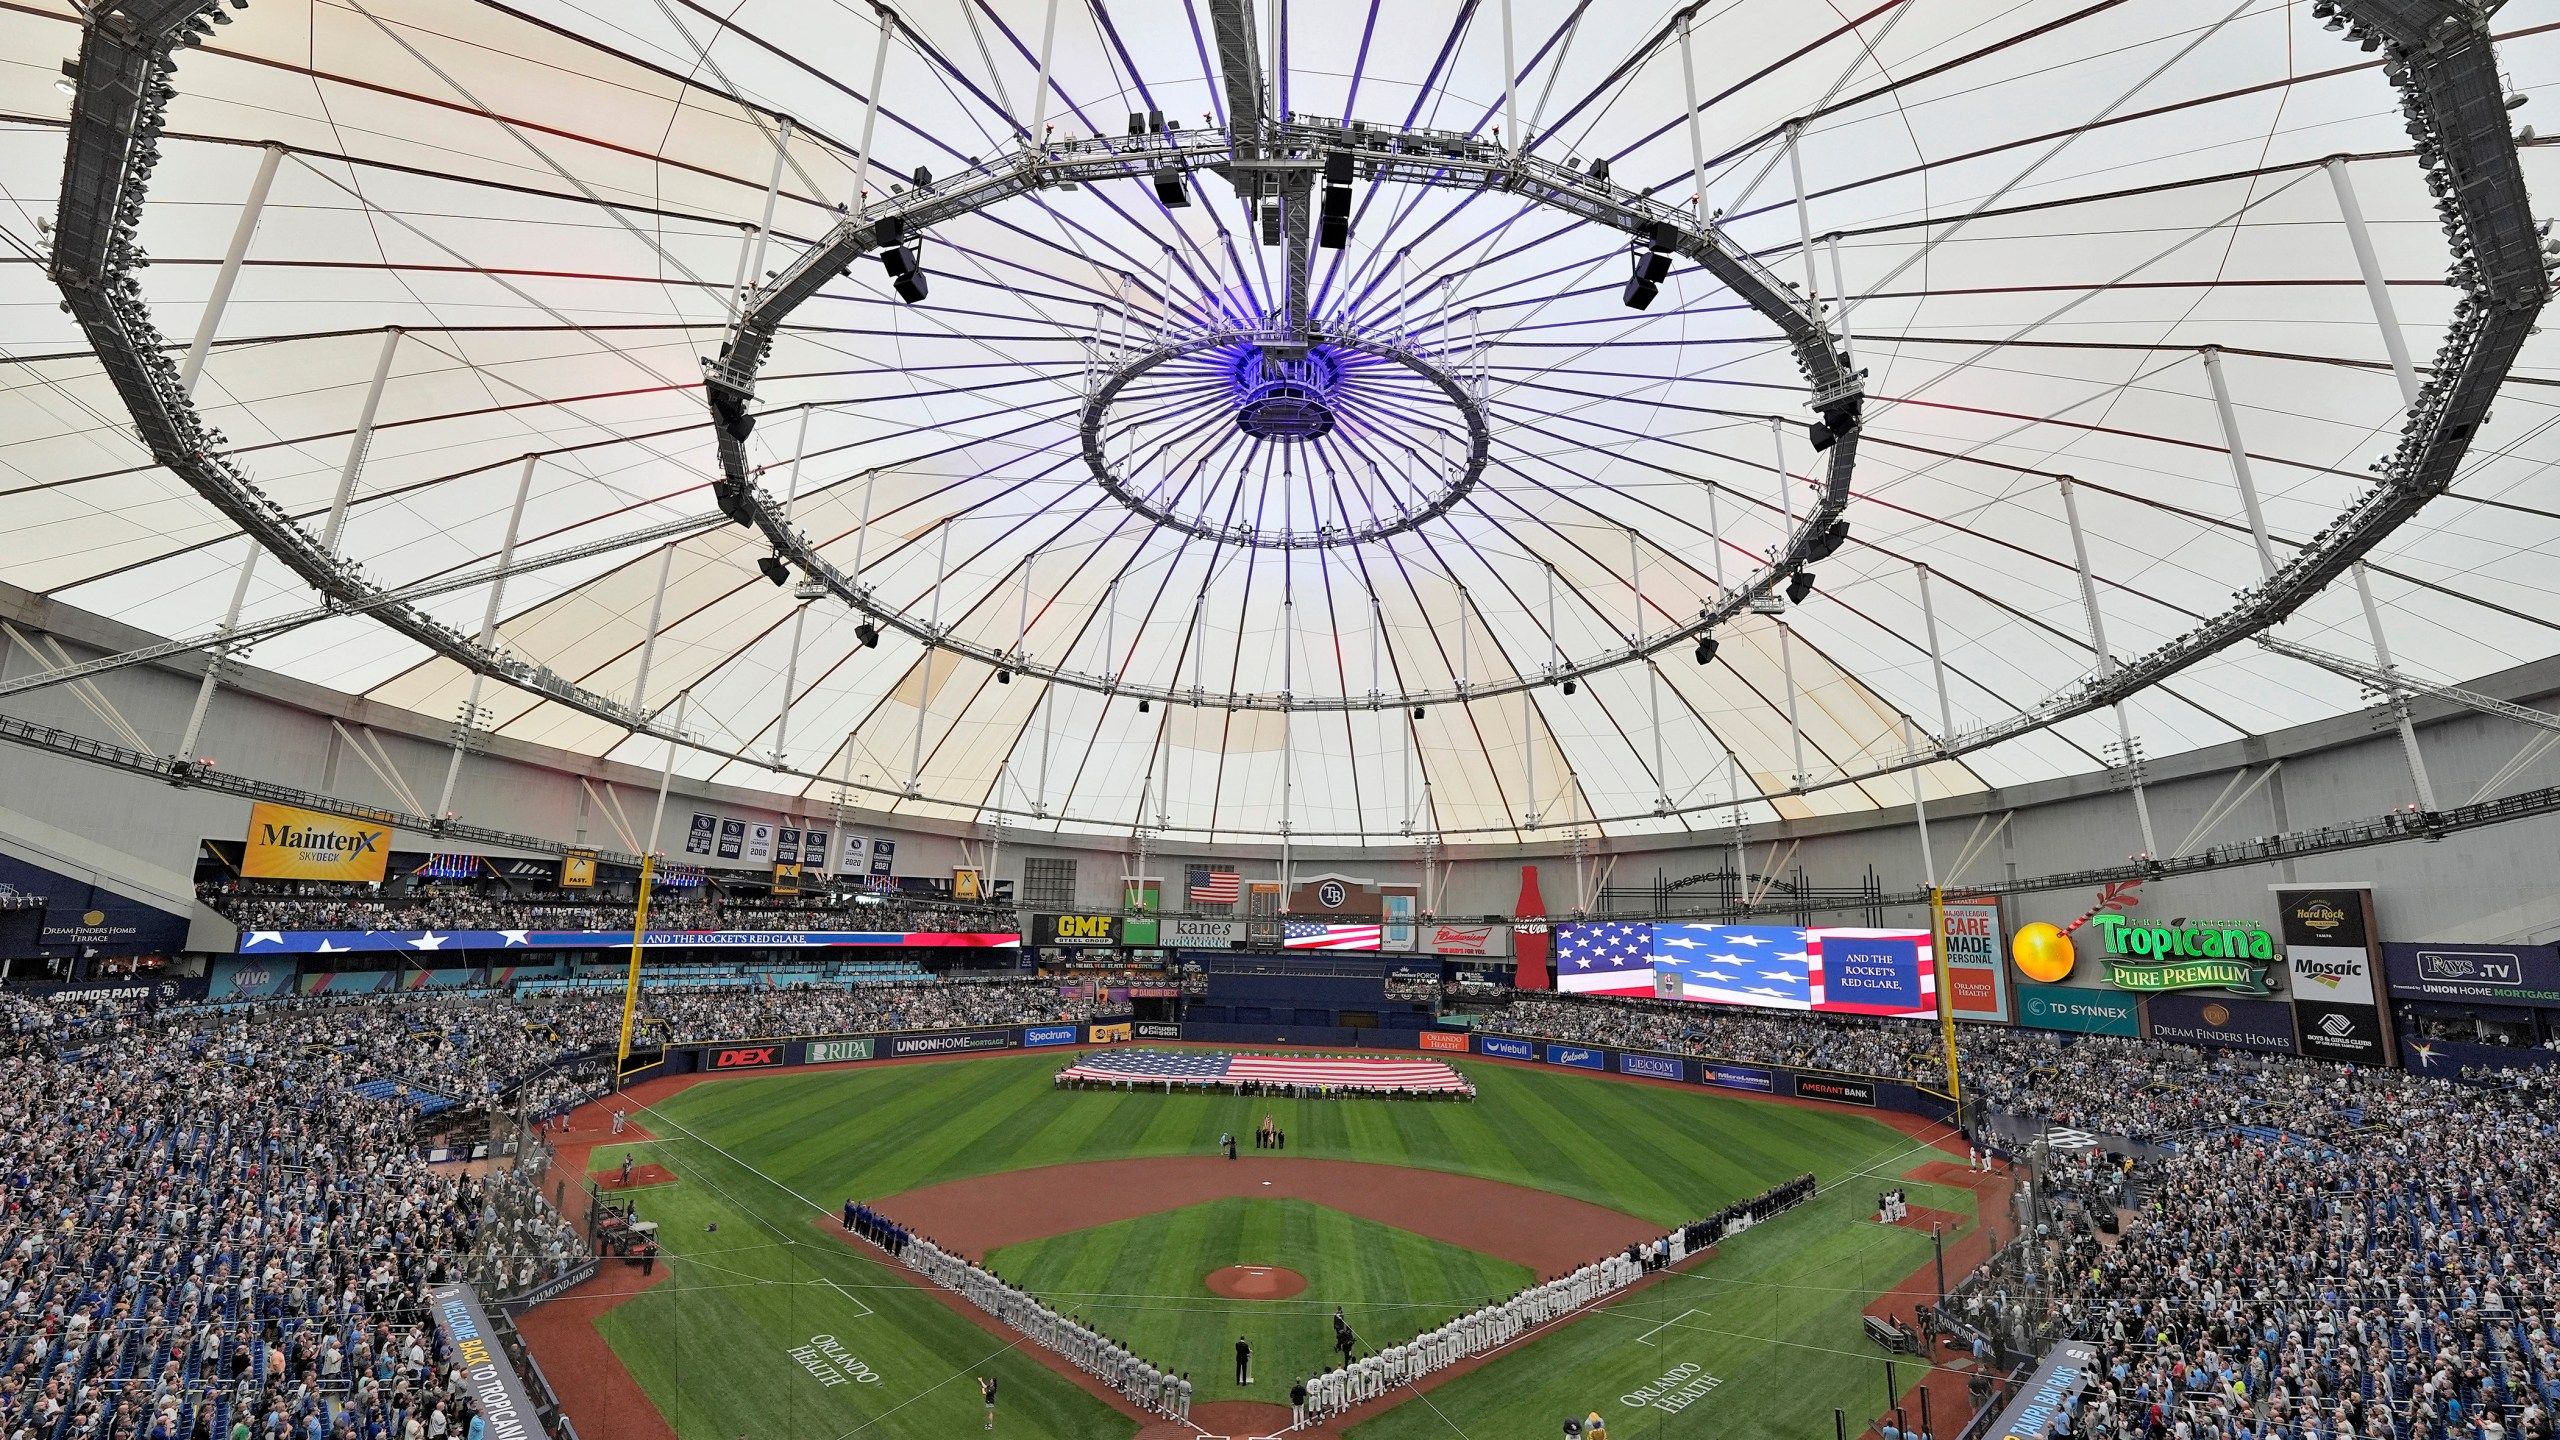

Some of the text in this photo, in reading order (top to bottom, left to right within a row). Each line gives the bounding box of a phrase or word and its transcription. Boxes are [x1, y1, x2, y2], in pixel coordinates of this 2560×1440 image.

[259, 823, 383, 862] MaintenX
[721, 844, 738, 853] 2008
[299, 852, 340, 862] SKYDECK
[750, 848, 766, 856] 2008
[780, 852, 794, 860] 2010
[806, 854, 822, 862] 2020
[845, 858, 862, 866] 2020
[874, 862, 888, 870] 2021
[1324, 886, 1341, 903] TB
[2297, 908, 2344, 920] Hard Rock
[43, 926, 136, 934] DREAM FINDERS HOMES
[1057, 915, 1112, 937] GMF
[1176, 920, 1232, 935] kanes
[1944, 918, 1990, 936] CARE
[70, 934, 108, 942] TERRACE
[646, 934, 807, 944] AND THE ROCKET'S RED GLARE,
[1437, 930, 1486, 941] Budweiser
[2092, 914, 2273, 961] Tropicana
[1946, 936, 1992, 954] MADE
[1846, 954, 1894, 964] AND THE
[1948, 954, 1993, 964] PERSONAL
[1845, 966, 1896, 976] ROCKET'S
[2295, 959, 2362, 976] Mosaic
[2426, 956, 2510, 978] RAYS .TV
[236, 970, 270, 986] VIVA
[2114, 966, 2250, 986] PURE PREMIUM
[1841, 978, 1902, 990] RED GLARE,
[1954, 982, 1991, 990] ORLANDO
[55, 987, 150, 1002] SOMOS RAYS
[1139, 990, 1178, 998] DAIQUIRI DECK
[2422, 984, 2458, 994] UNION
[2459, 986, 2492, 996] HOME
[2494, 988, 2560, 1000] MORTGAGE
[2050, 1002, 2127, 1019] TD SYNNEX
[1030, 1031, 1068, 1042] Spectrum
[1426, 1034, 1462, 1042] ORLANDO
[2154, 1024, 2290, 1048] DREAM FINDERS HOMES
[828, 1042, 868, 1060] RIPA
[1431, 1041, 1458, 1050] HEALTH
[1500, 1043, 1527, 1055] Webull
[717, 1048, 775, 1067] DEX
[1560, 1050, 1589, 1063] Culver's
[1628, 1058, 1674, 1072] LECOM
[1718, 1072, 1770, 1084] MicroLumen
[1802, 1082, 1868, 1098] AMERANT BANK
[528, 1266, 595, 1308] RAYMOND JAMES
[442, 1300, 479, 1342] WELCOME
[1938, 1314, 1974, 1344] RAYMOND
[458, 1339, 492, 1367] BACK
[810, 1334, 880, 1383] ORLANDO
[470, 1364, 498, 1380] TO
[786, 1344, 847, 1388] HEALTH
[1620, 1362, 1701, 1407] ORLANDO
[1651, 1374, 1724, 1414] HEALTH
[2010, 1365, 2081, 1436] TAMPA BAY RAYS
